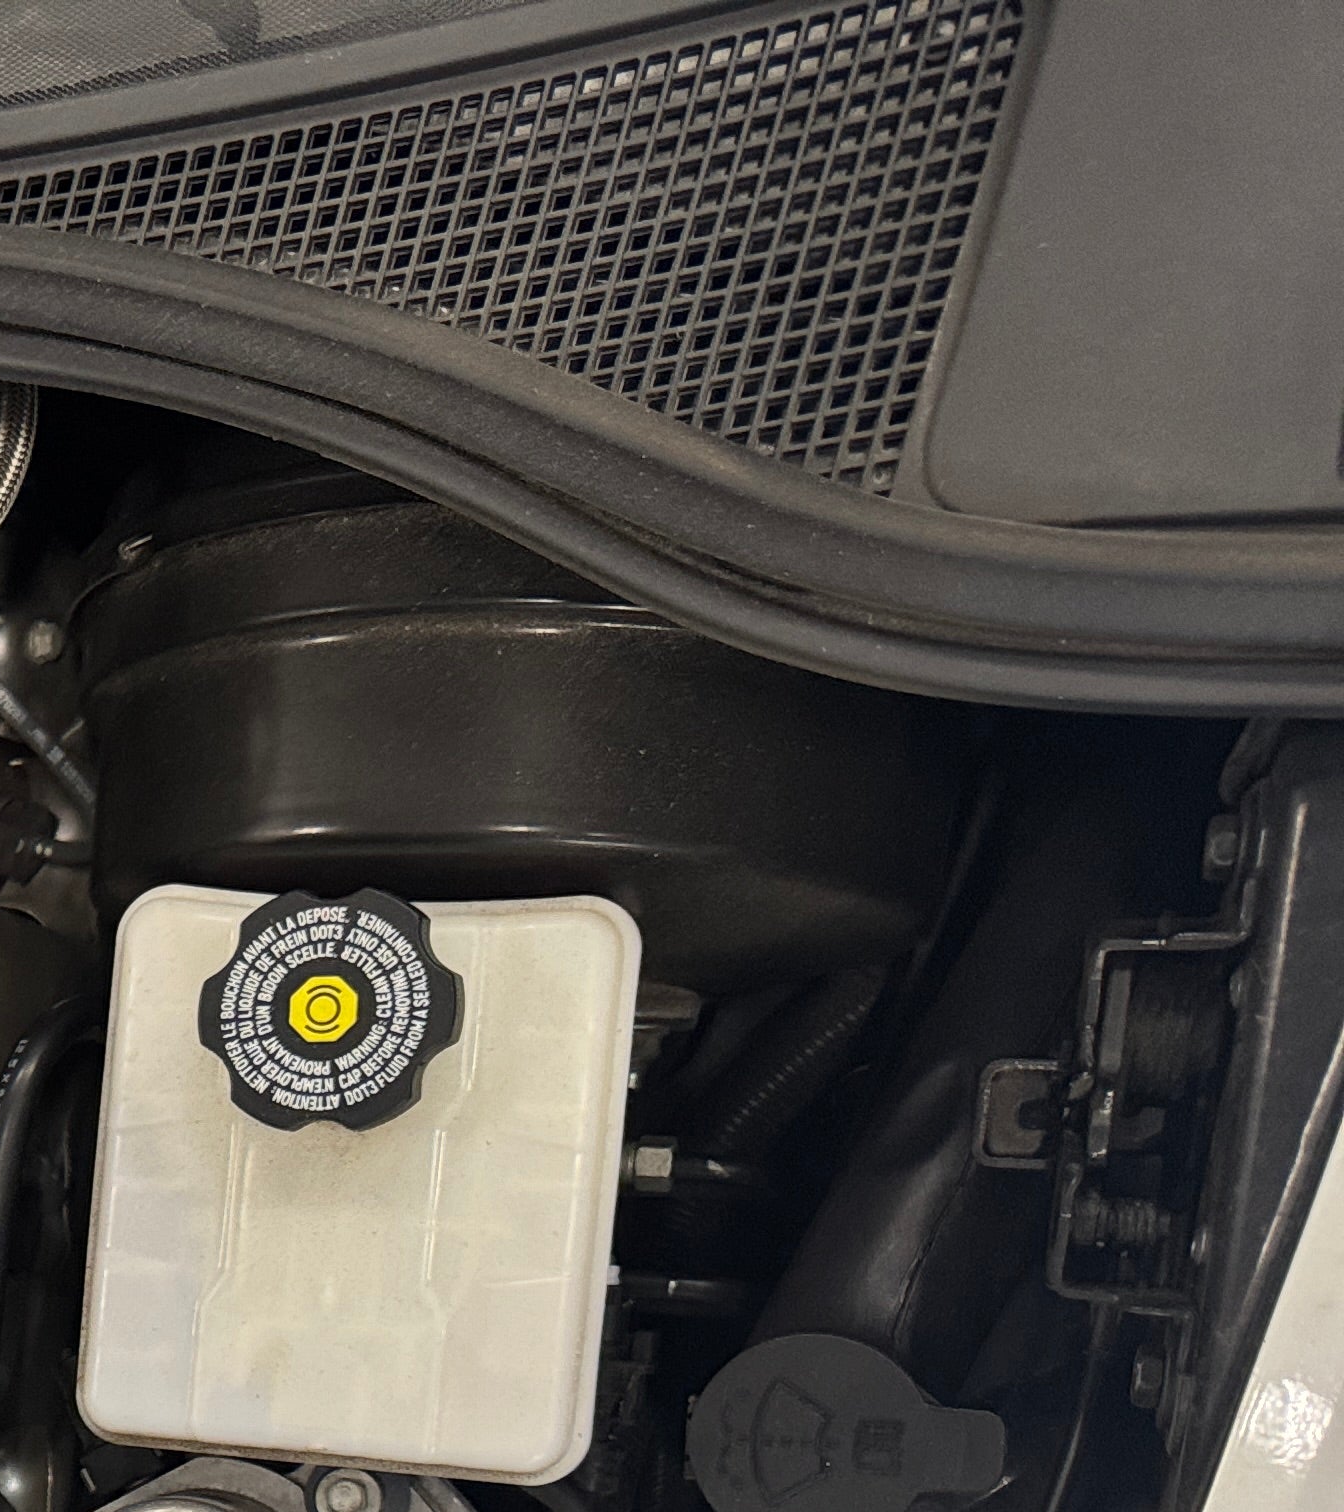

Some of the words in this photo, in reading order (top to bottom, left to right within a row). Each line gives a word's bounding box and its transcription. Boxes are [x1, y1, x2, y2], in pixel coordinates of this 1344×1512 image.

[276, 917, 296, 935] LA
[310, 924, 344, 941] DOT3
[345, 928, 379, 951] ONLY
[243, 928, 276, 964] AVANT
[271, 930, 308, 958] FREIN
[373, 944, 399, 970] USE
[255, 953, 275, 972] DE
[341, 945, 382, 979] FILLER
[220, 959, 248, 1019] BOUCHON
[238, 970, 264, 1018] LIQUIDE
[257, 964, 288, 1002] BIDON
[371, 976, 391, 1018] CLEAN
[409, 962, 430, 1007] SEALED
[413, 1009, 428, 1018] A
[221, 1022, 237, 1038] LE
[238, 1021, 255, 1039] DU
[400, 1020, 426, 1056] FROM
[243, 1039, 267, 1065] QUE
[262, 1036, 331, 1076] PROVENANT
[335, 1021, 387, 1071] WARNING:
[360, 1033, 402, 1077] BEFORE
[225, 1039, 270, 1093] NETTOYER
[339, 1069, 365, 1089] CAP
[375, 1054, 409, 1088] FLUID
[271, 1086, 340, 1111] ATTENTION:
[344, 1080, 379, 1105] DOT3
